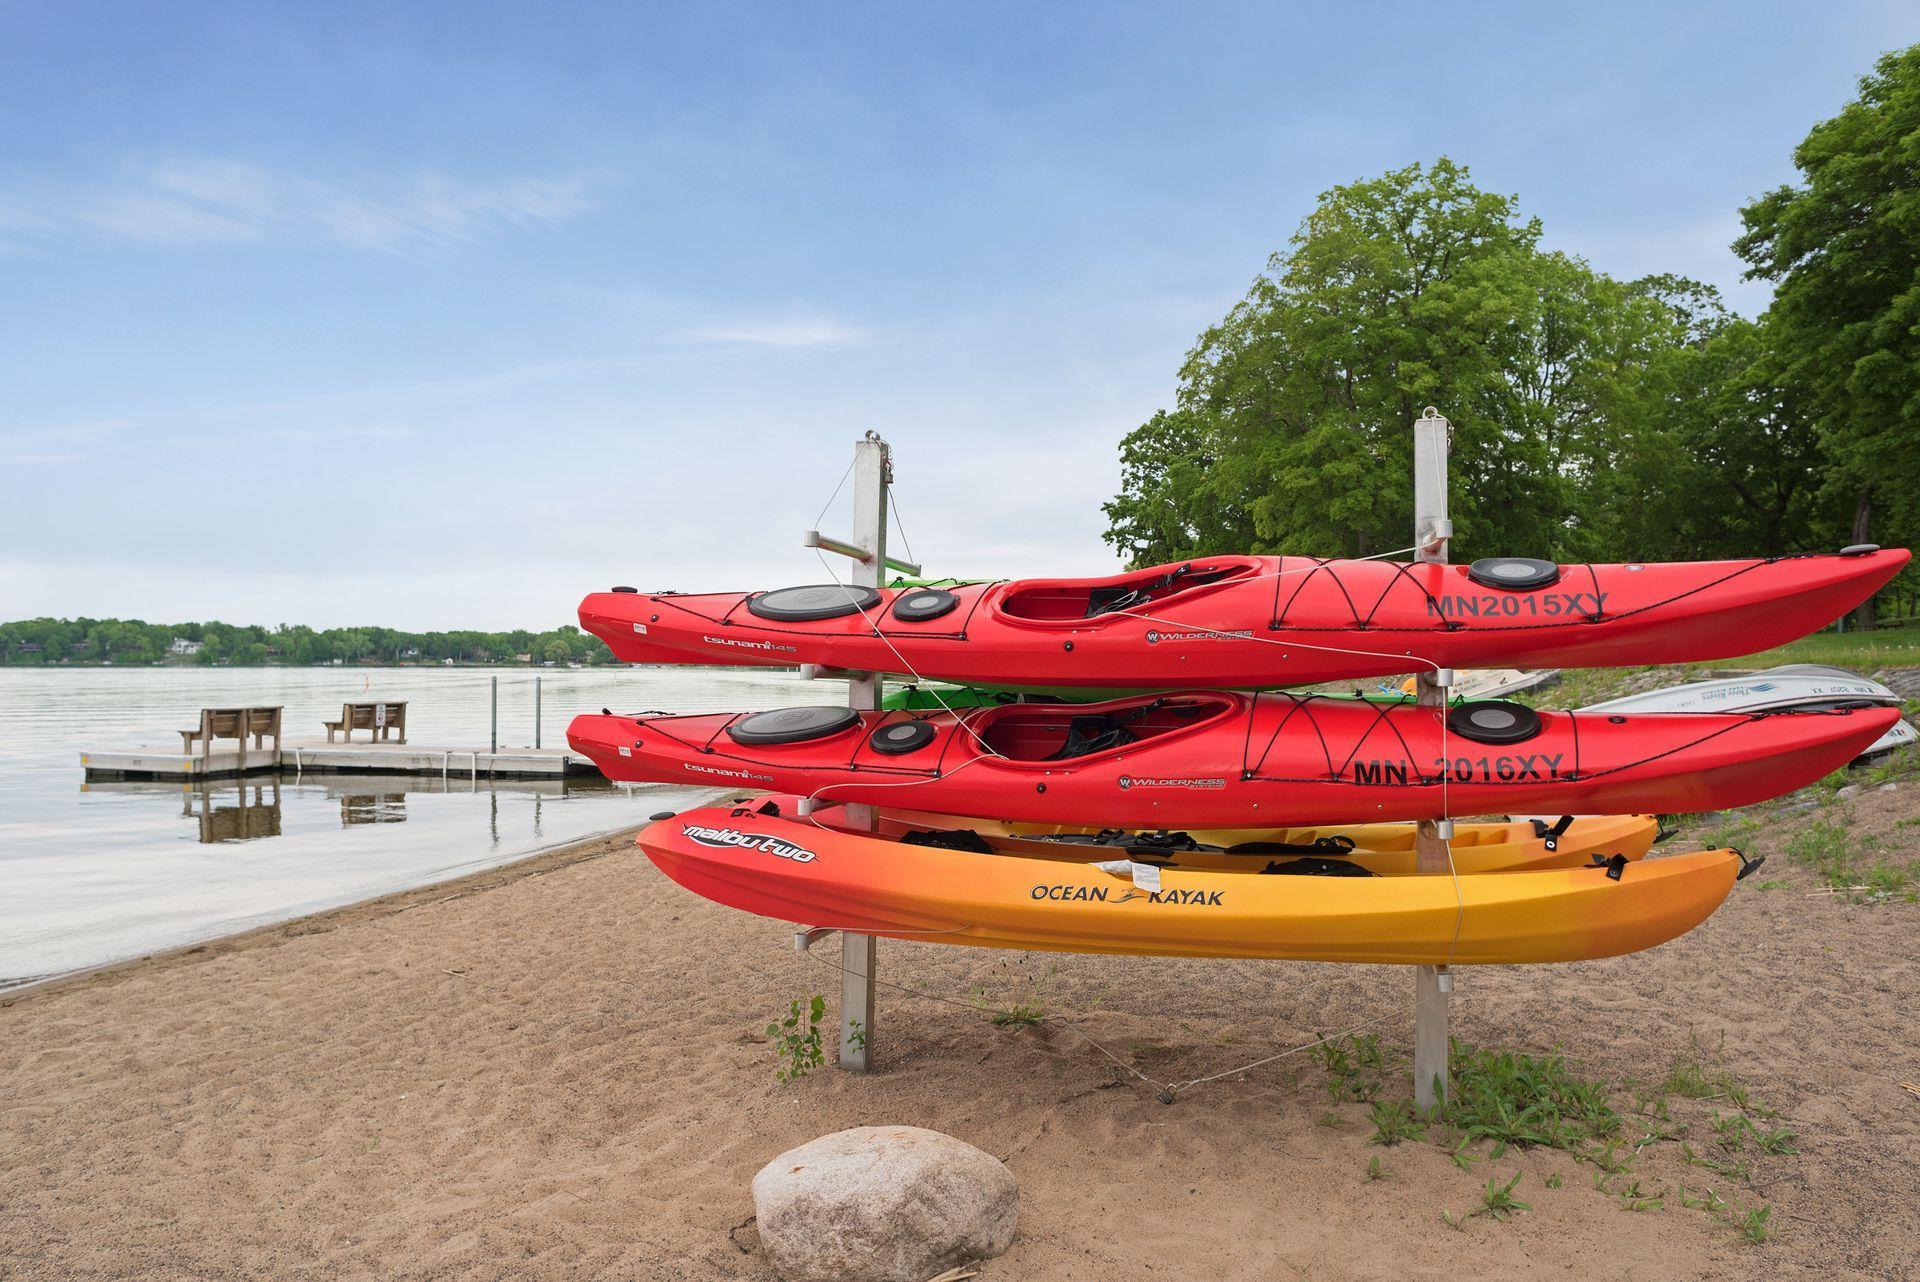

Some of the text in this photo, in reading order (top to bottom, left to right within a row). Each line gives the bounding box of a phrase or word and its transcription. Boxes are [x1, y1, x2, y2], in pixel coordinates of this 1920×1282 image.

[1427, 592, 1609, 617] MN2015XY
[1354, 753, 1564, 785] MN 2016XY
[1132, 777, 1226, 787] WILDERNESS
[681, 825, 817, 863] malibu two
[1030, 884, 1226, 906] OCEAN KAYAK
